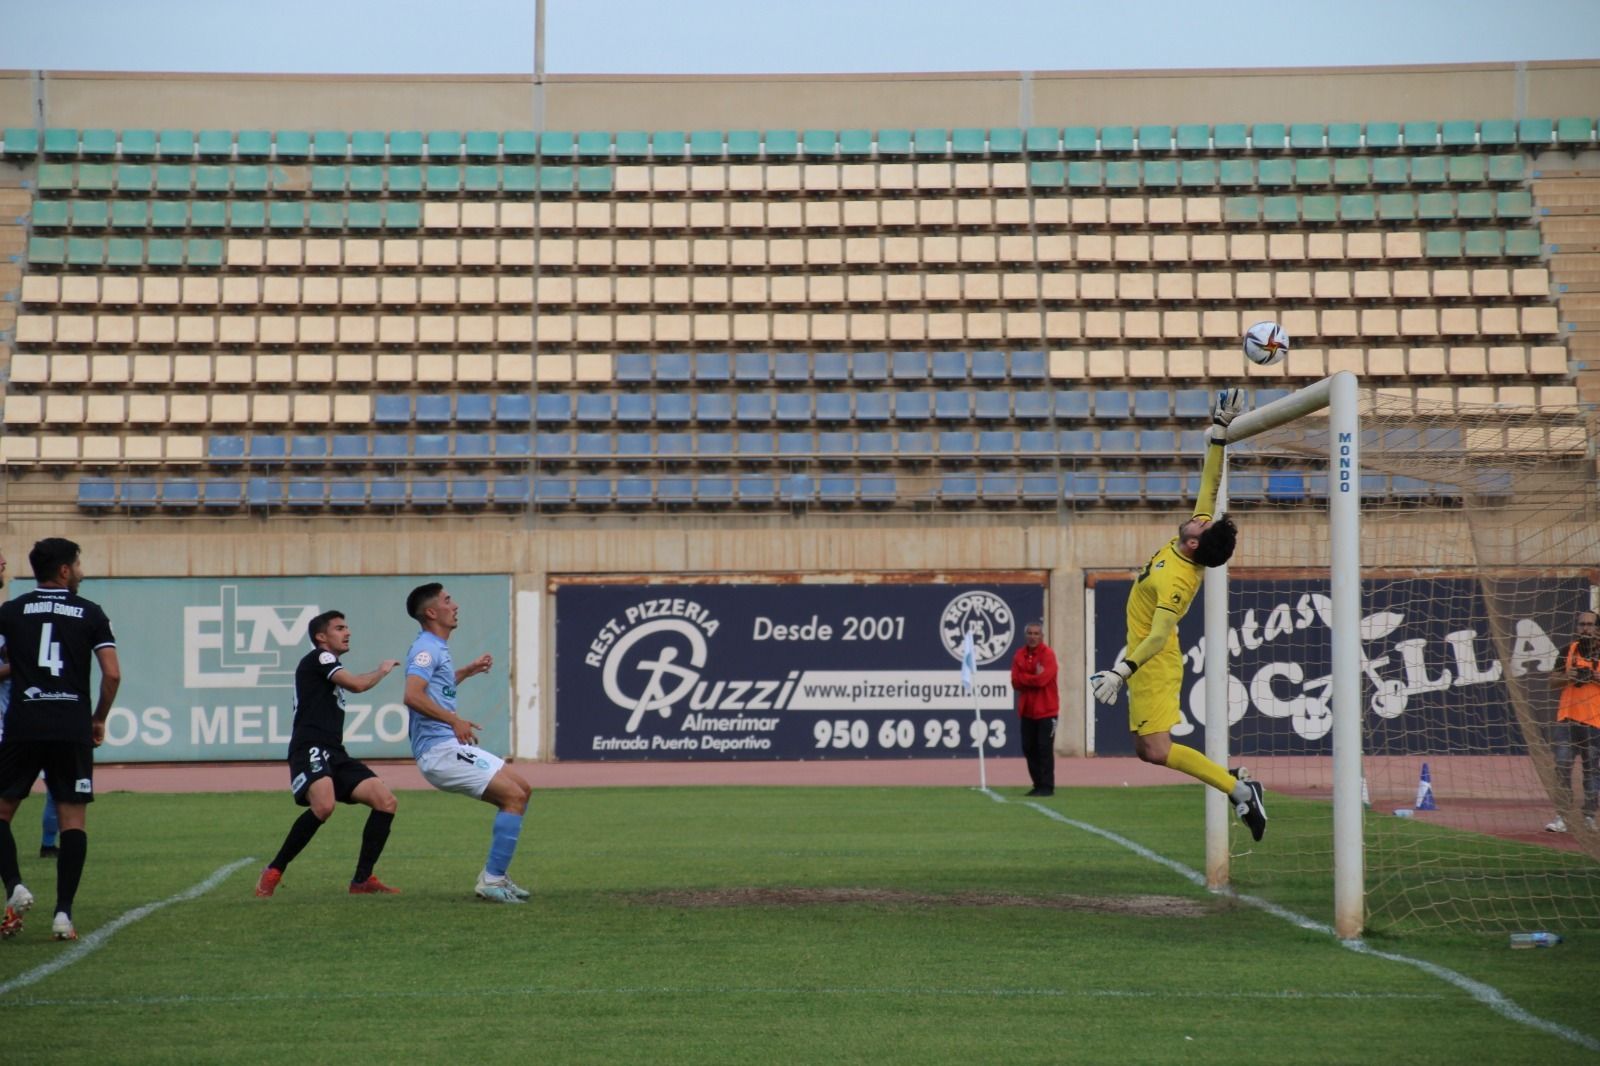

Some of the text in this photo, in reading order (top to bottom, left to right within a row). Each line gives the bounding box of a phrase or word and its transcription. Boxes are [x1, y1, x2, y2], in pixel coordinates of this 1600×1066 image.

[1338, 432, 1352, 492] MONDO
[945, 595, 1010, 624] HORNO
[585, 598, 720, 668] REST. PIZZERIA
[752, 614, 905, 641] Desde 2001
[38, 622, 64, 677] 4
[104, 705, 172, 746] OS
[680, 713, 780, 732] Almerimar
[813, 718, 1007, 749] 950 60 93 93
[592, 735, 772, 752] Entrada Puerto Deportivo
